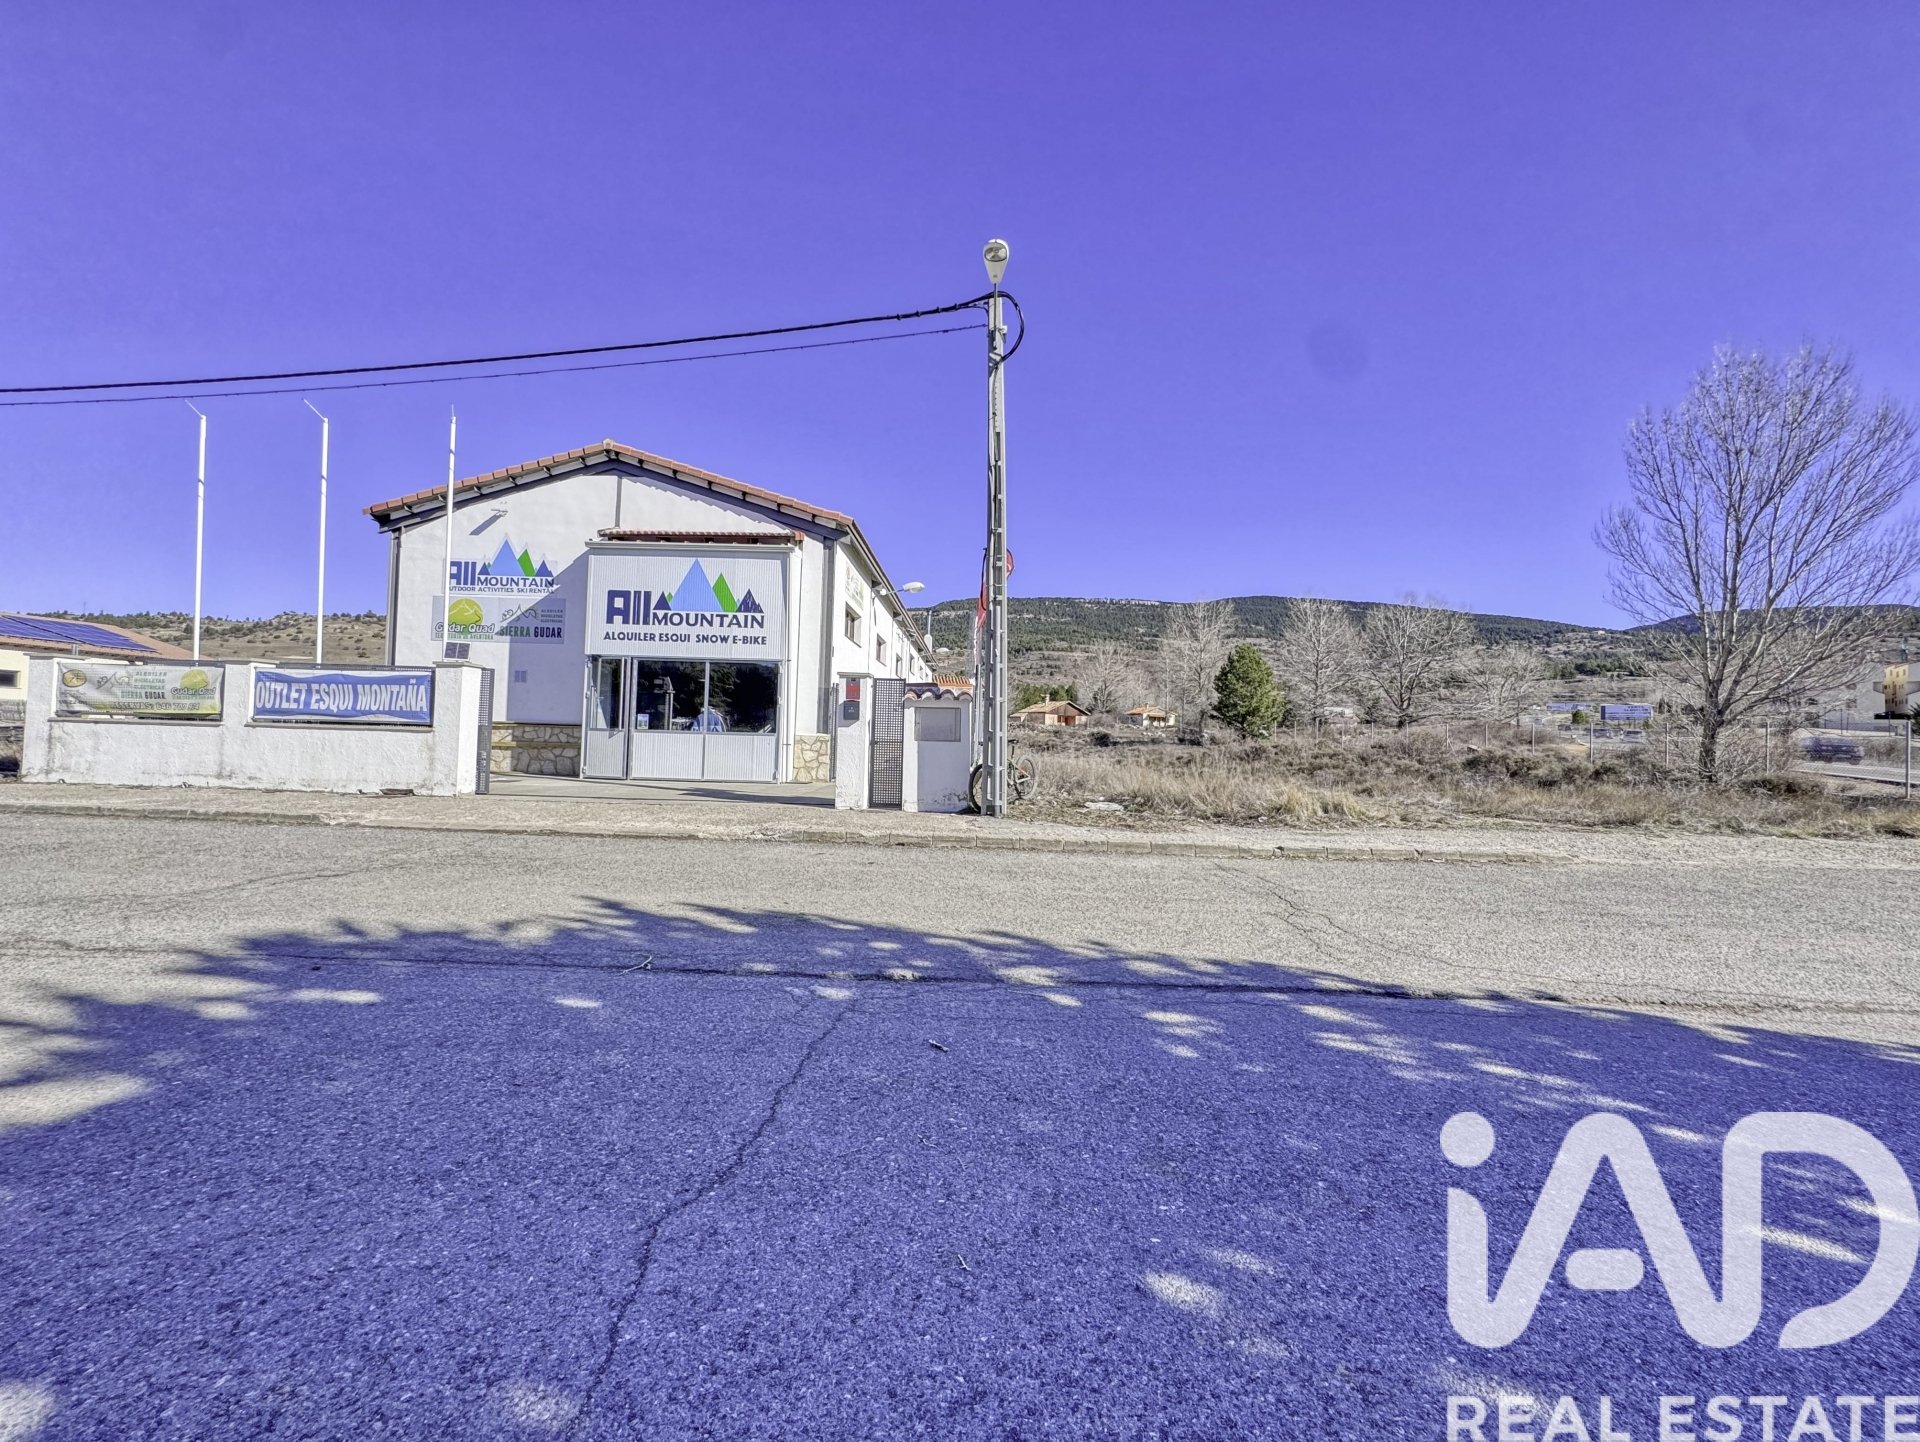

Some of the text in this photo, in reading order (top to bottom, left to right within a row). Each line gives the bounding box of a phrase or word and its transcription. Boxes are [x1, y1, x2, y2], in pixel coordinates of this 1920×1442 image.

[477, 576, 555, 588] MOUNTAIN
[652, 612, 765, 629] MOUNTAIN
[435, 622, 495, 633] Gdar Quad
[500, 626, 562, 638] SIERRA GUDAR
[603, 631, 767, 645] ALQUILER ESQUI SNOW E-BIKE
[255, 678, 428, 713] OUTLET ESQUI MONTAÑA
